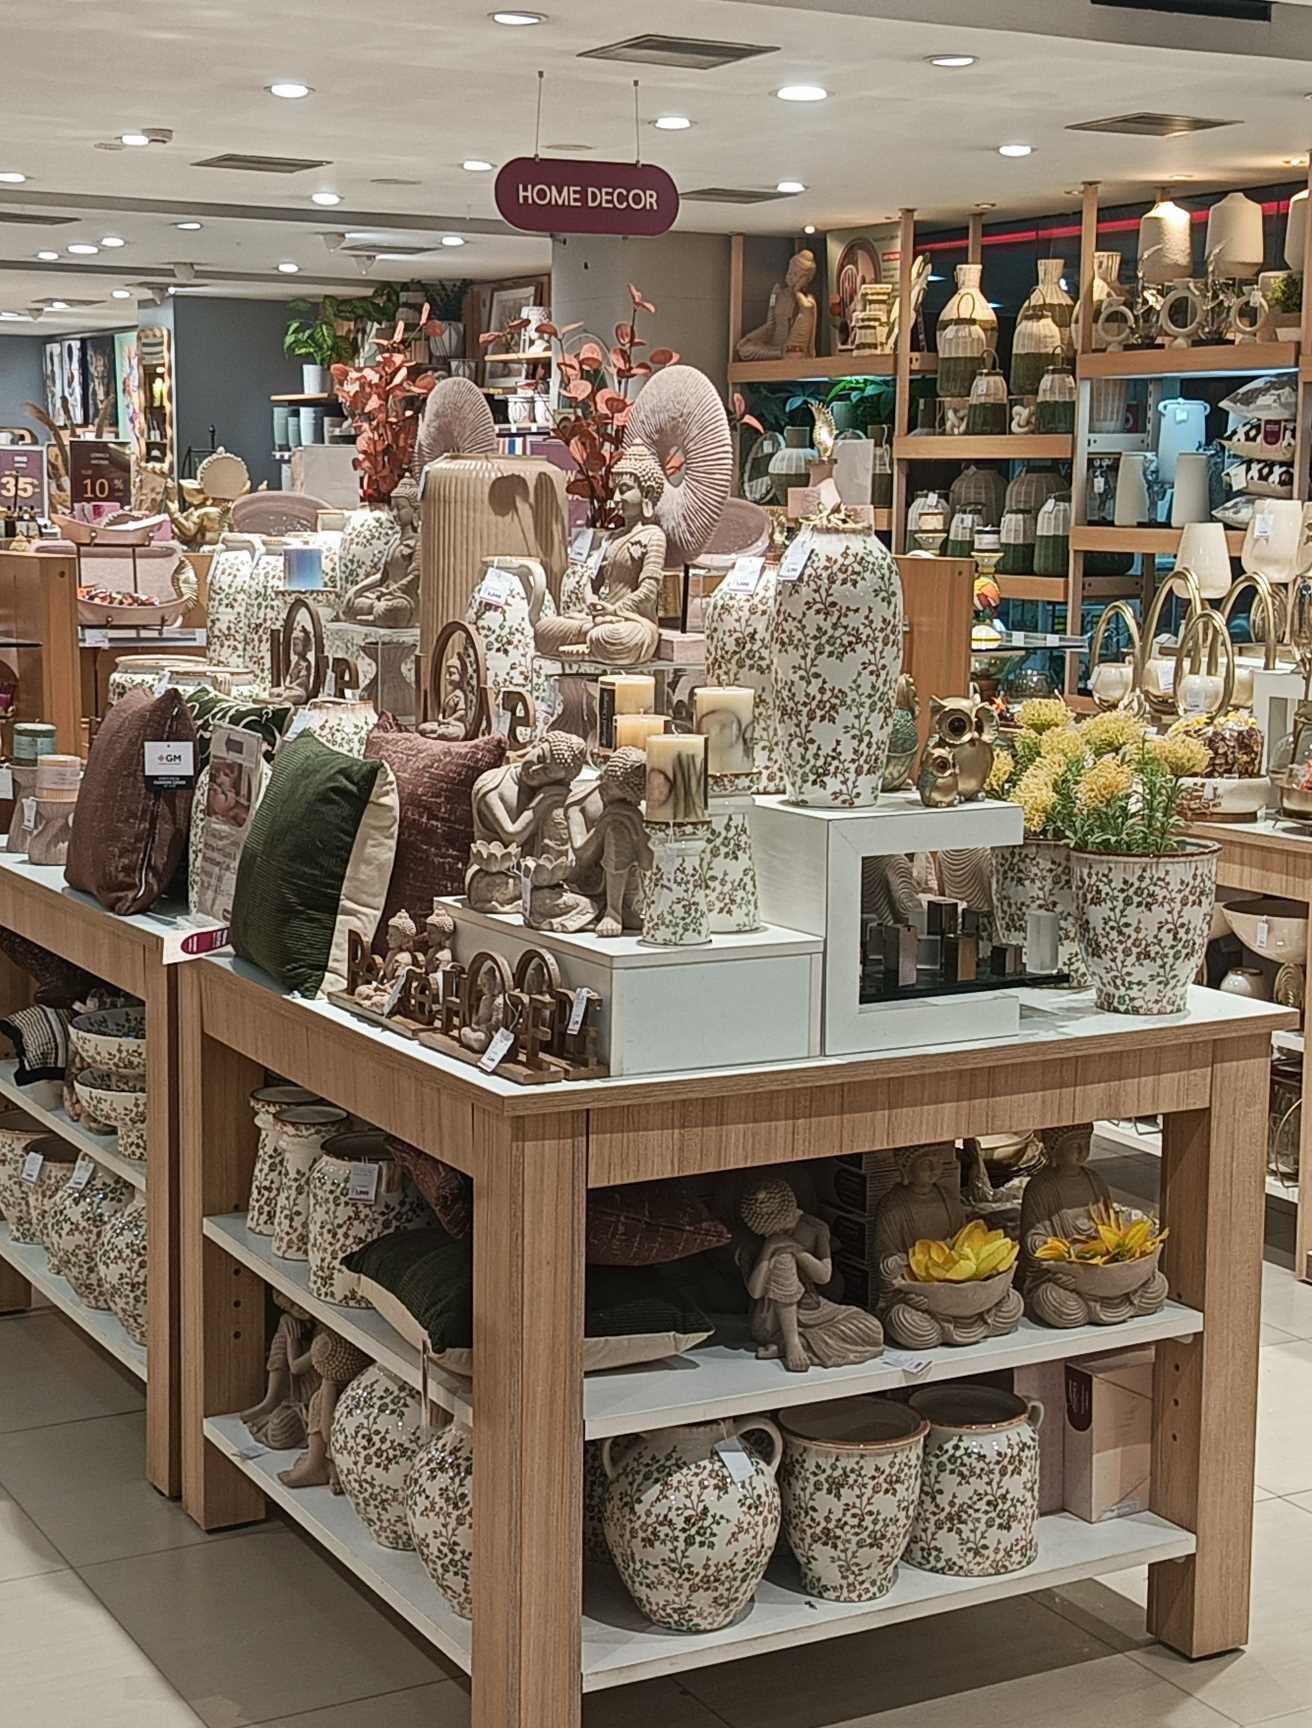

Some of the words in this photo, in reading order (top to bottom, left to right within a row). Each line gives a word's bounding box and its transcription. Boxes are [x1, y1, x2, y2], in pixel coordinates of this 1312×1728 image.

[518, 184, 582, 207] HOME
[587, 187, 658, 210] DECOR
[83, 478, 109, 498] 10
